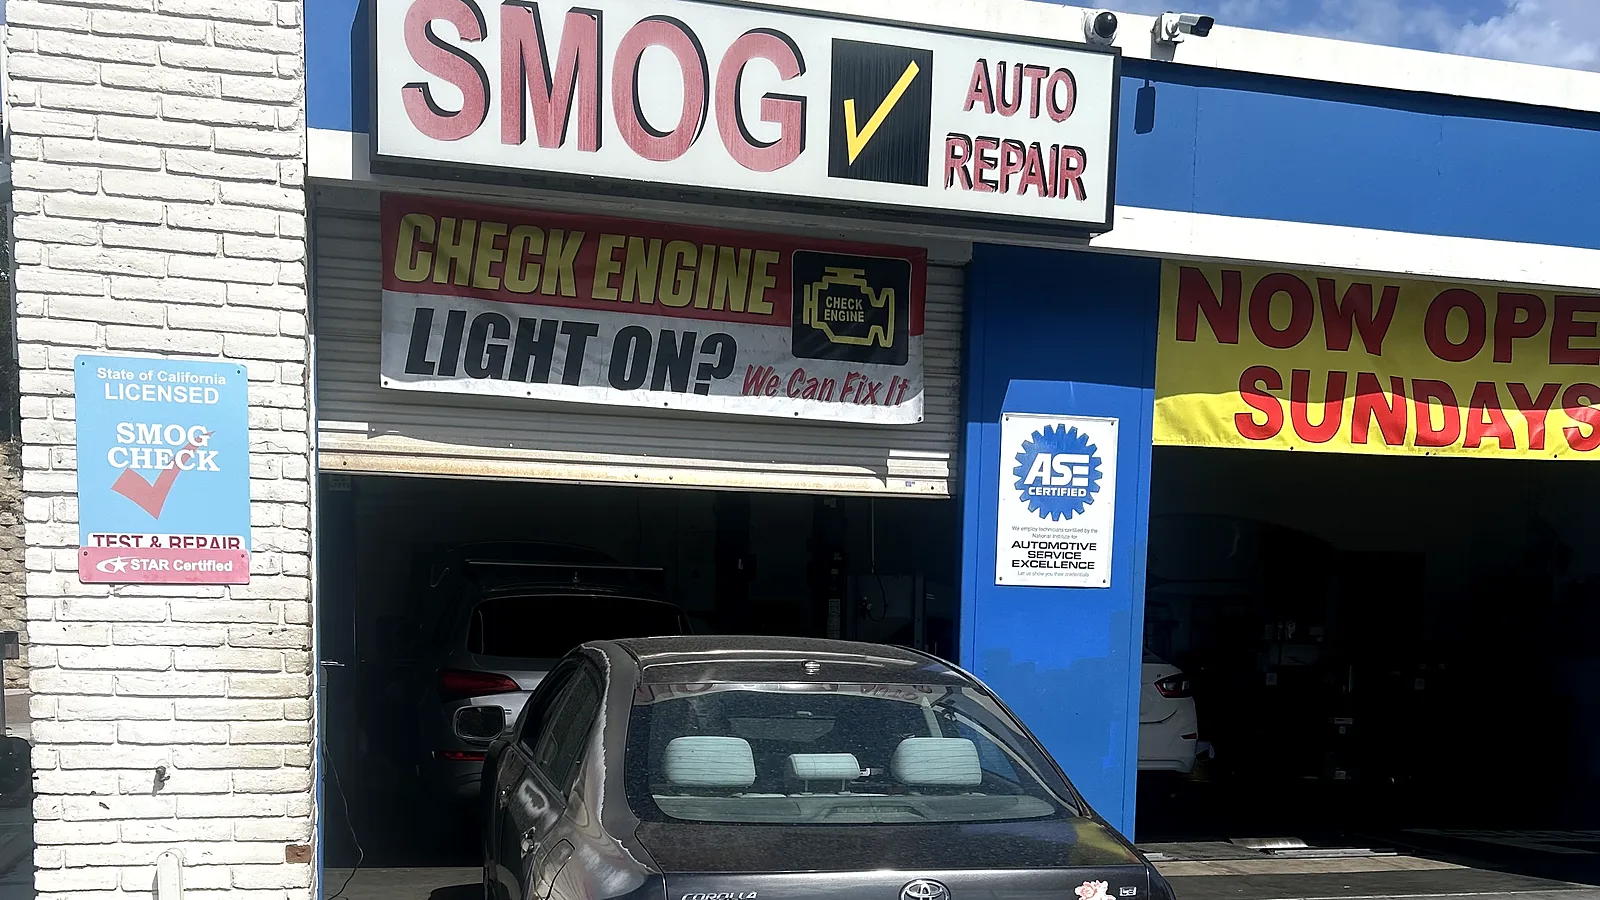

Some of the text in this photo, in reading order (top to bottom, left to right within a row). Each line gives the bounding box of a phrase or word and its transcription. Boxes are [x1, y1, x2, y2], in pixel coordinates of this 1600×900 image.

[401, 0, 806, 172] SMOG
[964, 58, 1077, 122] AUTO
[943, 133, 1087, 202] REPAIR
[393, 213, 780, 315] CHECK ENGINE
[825, 295, 863, 310] CHECK
[1175, 266, 1400, 356] NOW
[824, 309, 865, 323] ENGINE
[404, 307, 737, 396] LIGHT ON?
[97, 368, 226, 385] State of California
[742, 364, 910, 407] We Can Fix It
[105, 383, 219, 405] LICENSED
[1234, 365, 1600, 452] SUNDAYS
[116, 422, 210, 447] SMOG
[107, 448, 220, 472] CHECK
[1023, 453, 1089, 487] ASE
[1028, 487, 1087, 497] CERTIFIED
[93, 534, 240, 549] TEST & REPAIR
[1011, 540, 1097, 551] AUTOMOTIVE
[130, 559, 233, 572] STAR Certified
[1011, 559, 1095, 569] EXCELLENCE
[1027, 550, 1082, 560] SERVICE
